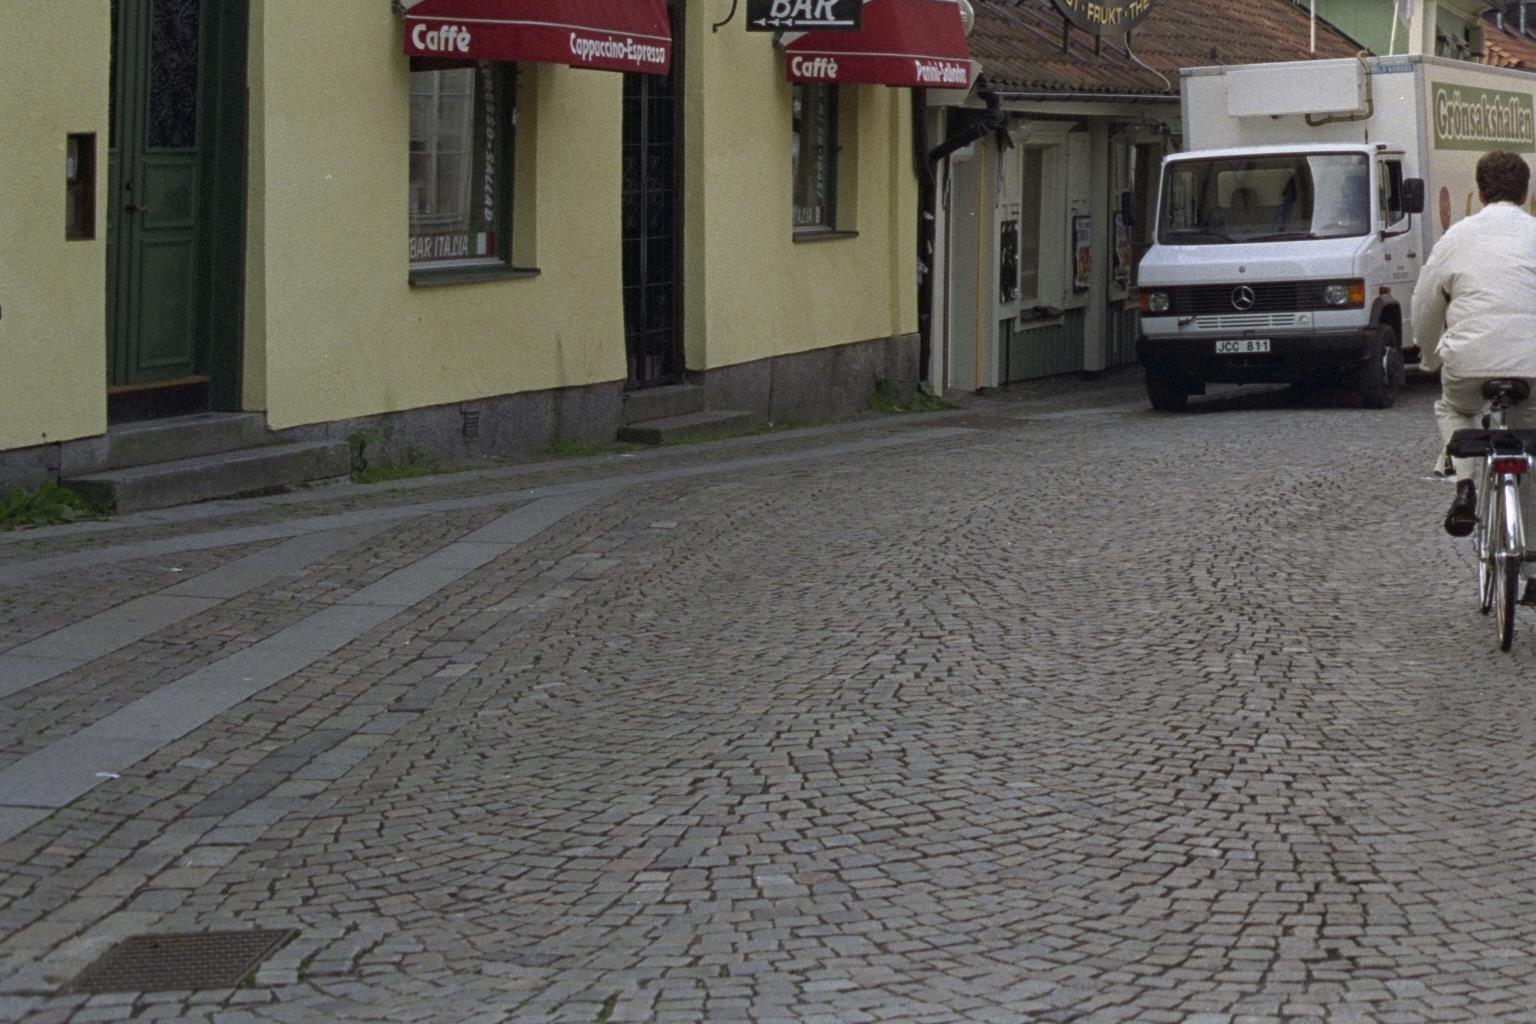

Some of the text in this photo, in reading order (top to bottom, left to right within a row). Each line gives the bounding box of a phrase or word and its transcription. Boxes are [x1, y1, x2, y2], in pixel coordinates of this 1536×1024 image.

[1087, 2, 1122, 24] FRUKT
[412, 24, 472, 52] Caffè
[569, 32, 665, 66] Cappuccino-Espresso
[791, 56, 839, 79] Caffè
[1436, 88, 1534, 143] Grönsakshallen
[410, 237, 432, 258] BAR
[1218, 341, 1268, 352] JCC 811
